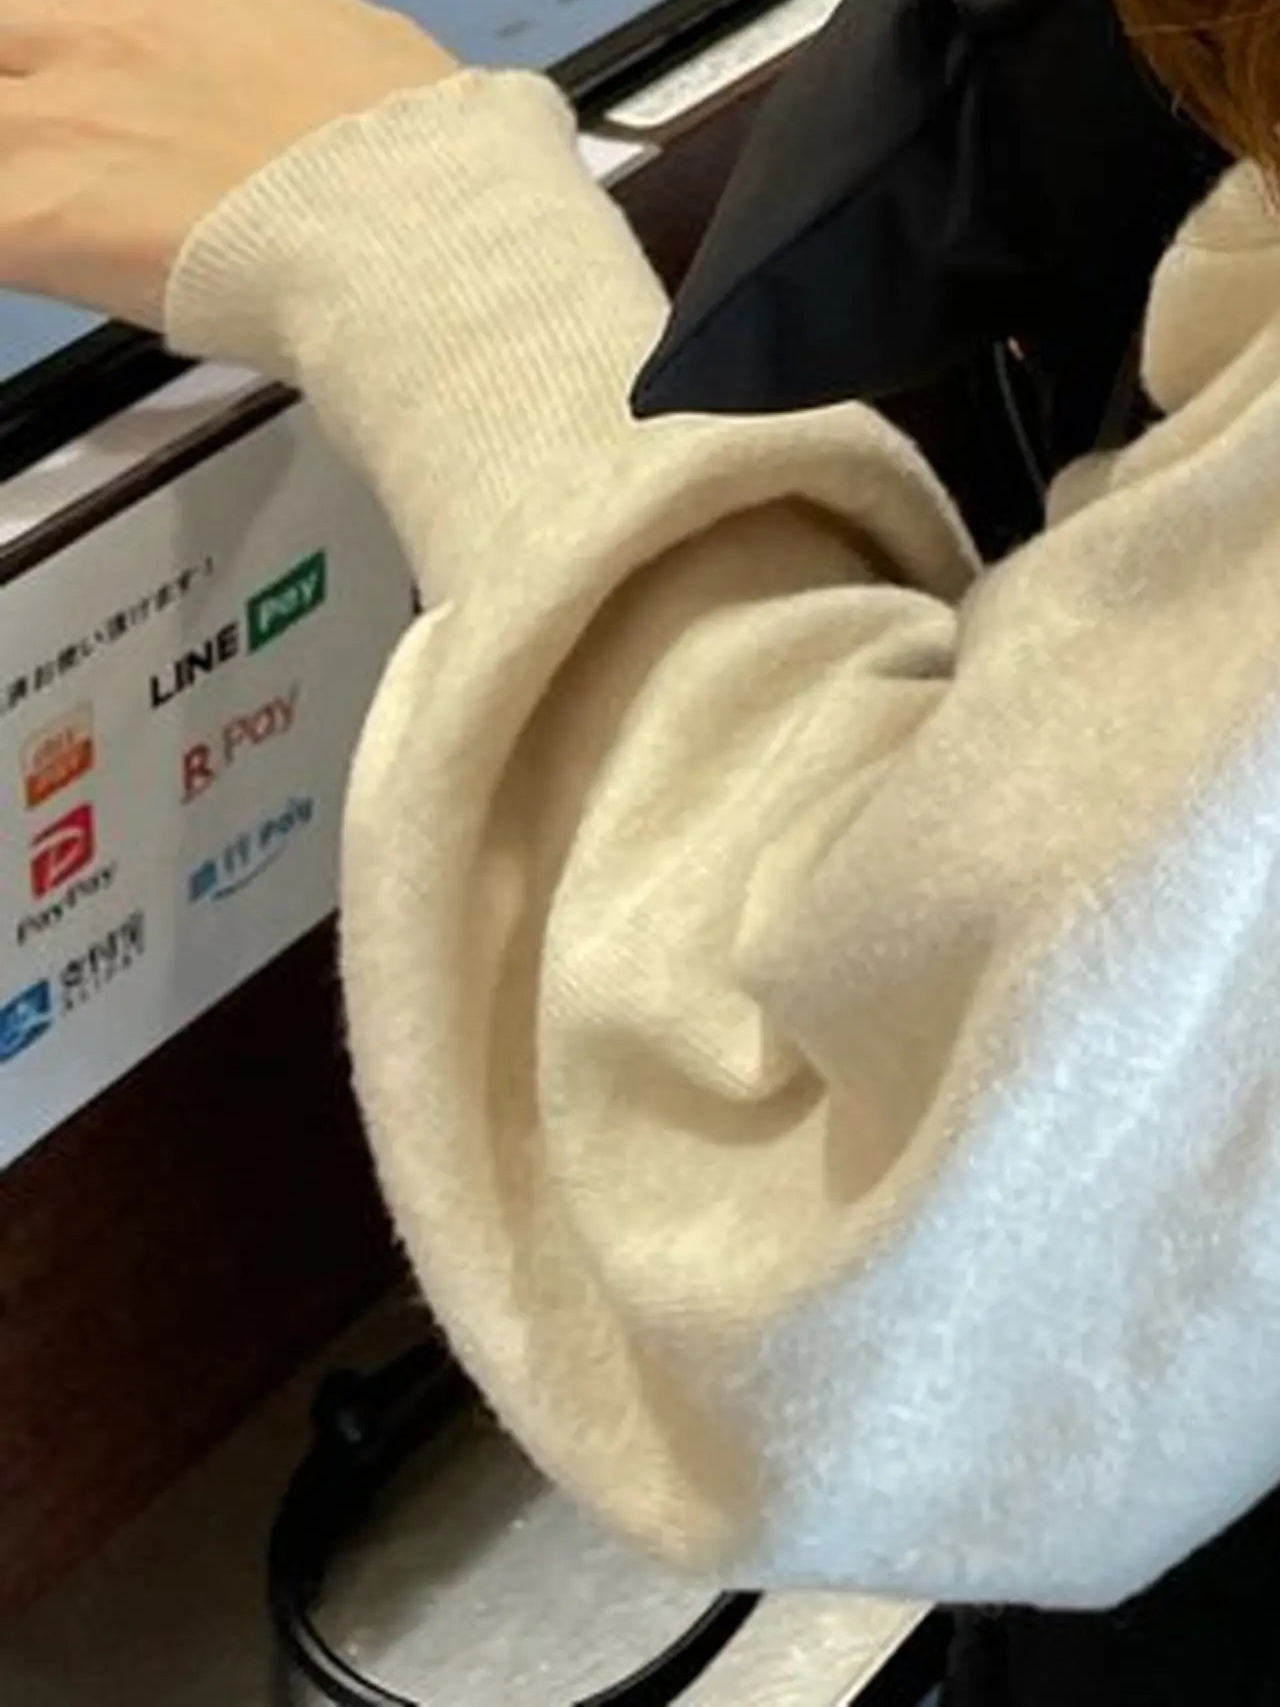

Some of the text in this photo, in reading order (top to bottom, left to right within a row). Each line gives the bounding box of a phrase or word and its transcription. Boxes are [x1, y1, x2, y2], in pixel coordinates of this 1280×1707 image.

[150, 620, 240, 709] LINE
[180, 684, 299, 806] R Pay
[17, 859, 118, 946] PayPay
